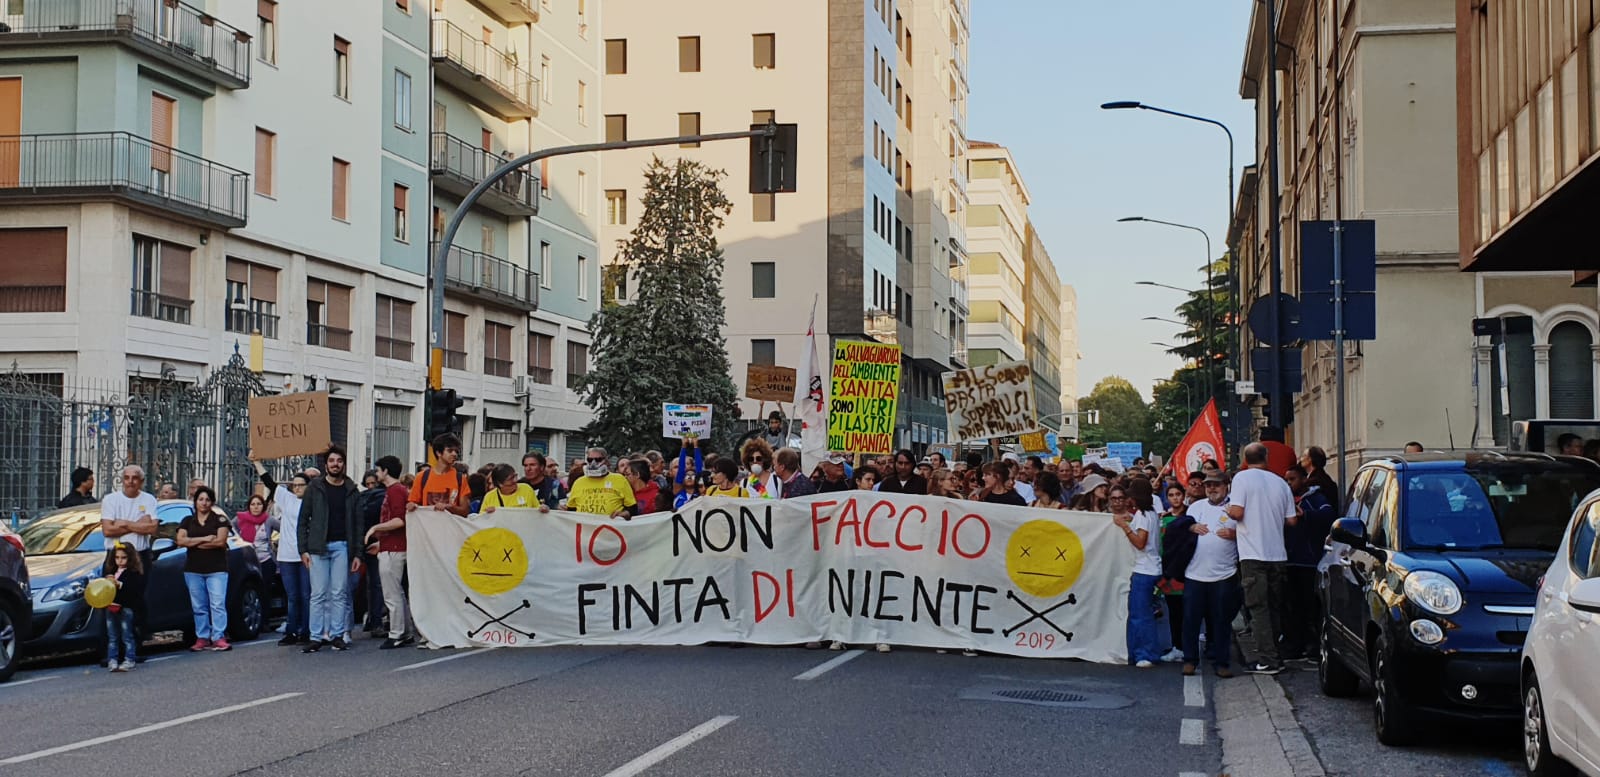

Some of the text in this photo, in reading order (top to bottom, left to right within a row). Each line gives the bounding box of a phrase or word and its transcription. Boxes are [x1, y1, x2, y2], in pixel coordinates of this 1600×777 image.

[835, 343, 899, 364] LA SALVAGUARDIA
[767, 374, 792, 382] BASTA
[766, 383, 793, 392] VELENI
[831, 381, 838, 395] E
[268, 399, 317, 416] BASTA
[861, 398, 894, 417] VERI
[945, 383, 996, 414] BASTA
[257, 423, 307, 440] VELENI
[829, 413, 891, 433] PILASTRI
[575, 498, 992, 567] IO NON FACCIO
[578, 568, 998, 635] FINTA DI NIENTE
[482, 629, 517, 645] 2016
[1015, 632, 1056, 650] 2019
